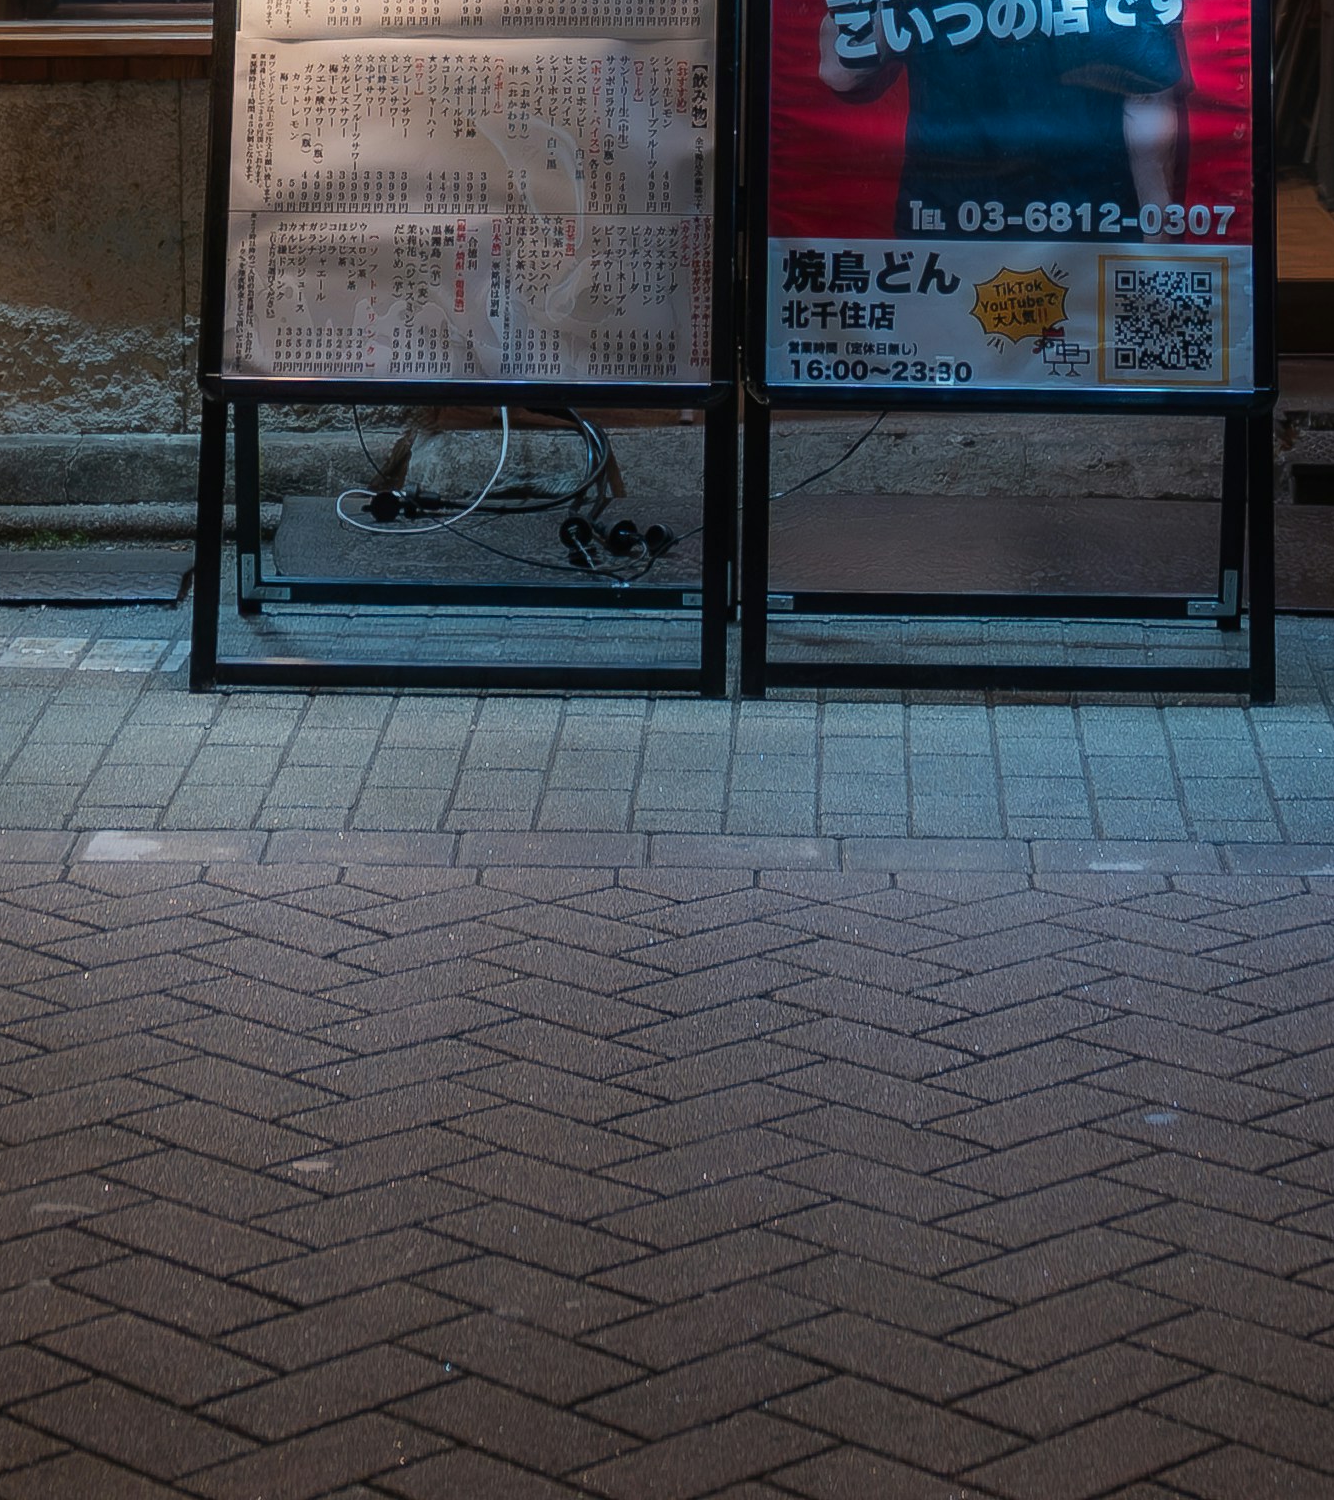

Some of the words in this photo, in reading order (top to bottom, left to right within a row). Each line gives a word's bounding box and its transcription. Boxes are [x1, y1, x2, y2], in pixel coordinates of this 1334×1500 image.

[957, 200, 1236, 236] 03-6812-0307
[781, 250, 961, 296] 焼鳥どん
[992, 279, 1044, 299] TikTok
[781, 300, 896, 331] 北千住店
